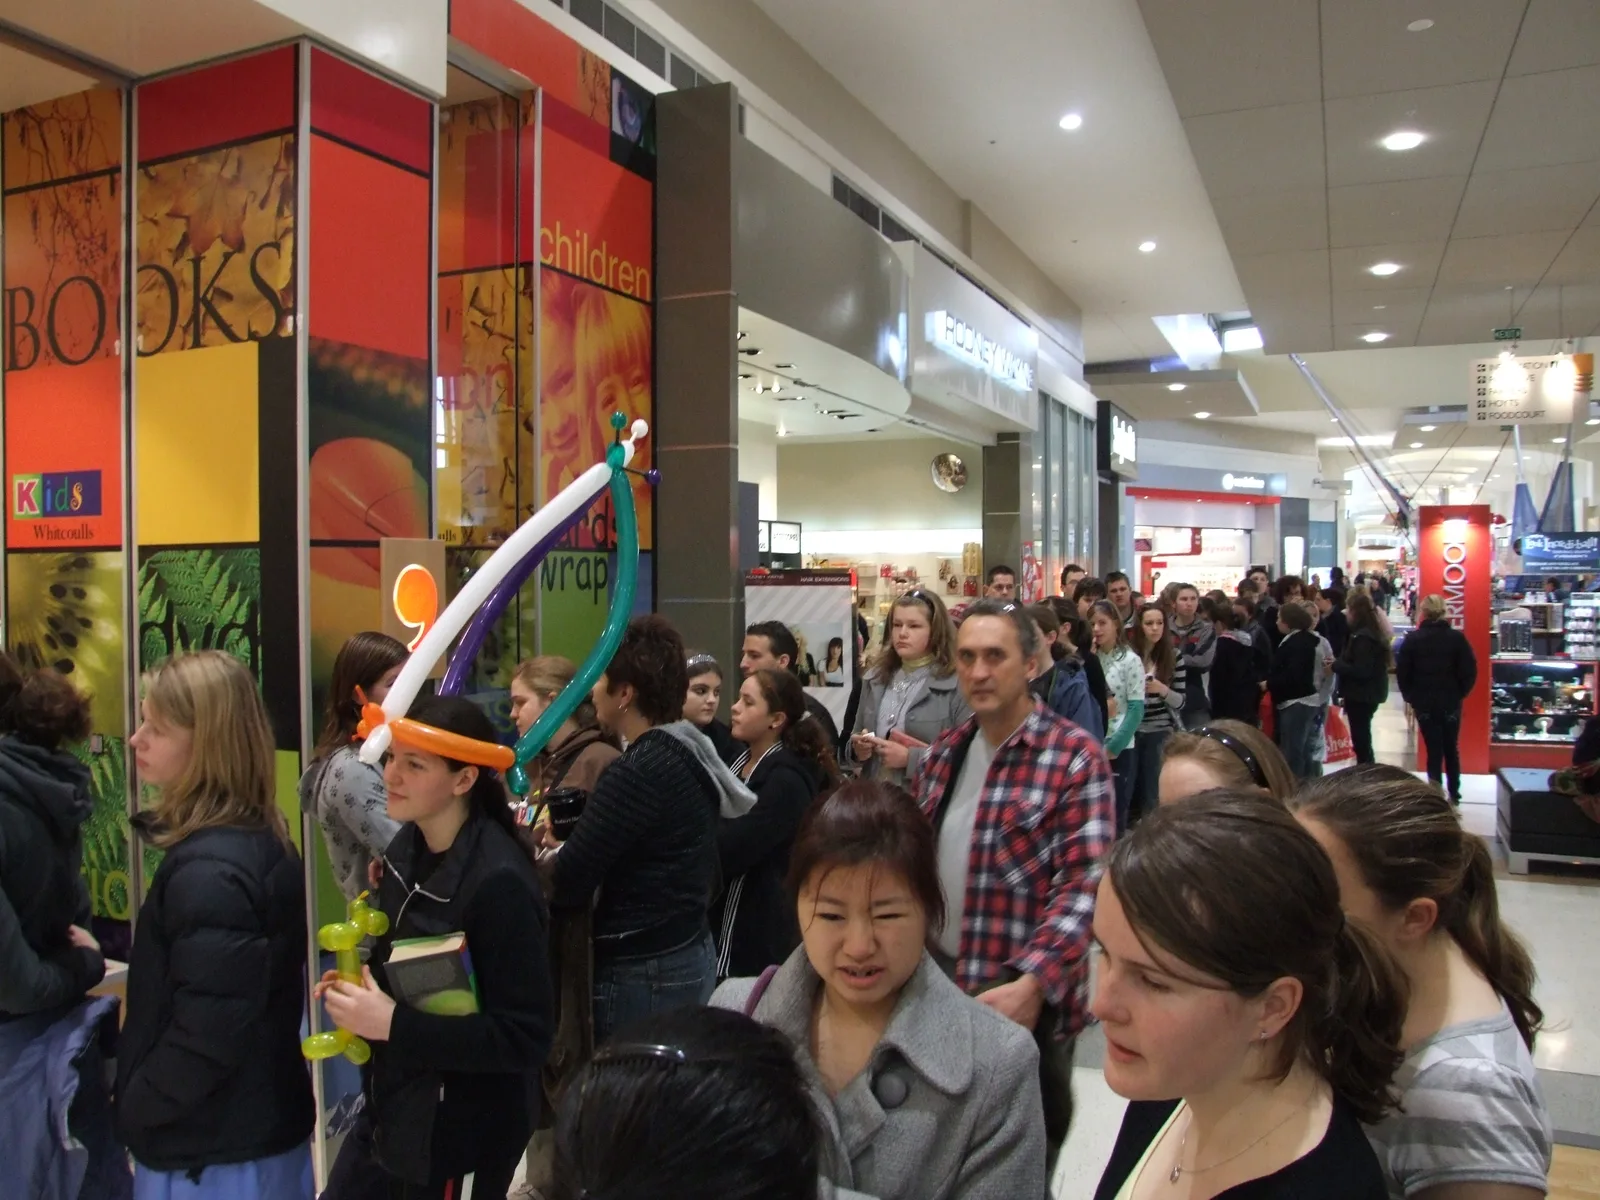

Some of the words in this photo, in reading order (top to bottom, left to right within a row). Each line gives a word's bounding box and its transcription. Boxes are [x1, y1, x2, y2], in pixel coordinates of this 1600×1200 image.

[540, 221, 650, 302] children
[5, 241, 282, 372] BOOKS
[1489, 410, 1546, 419] FOODCOURT
[16, 476, 84, 515] Kids
[33, 523, 95, 541] Whitcoulls
[541, 555, 608, 605] wrap
